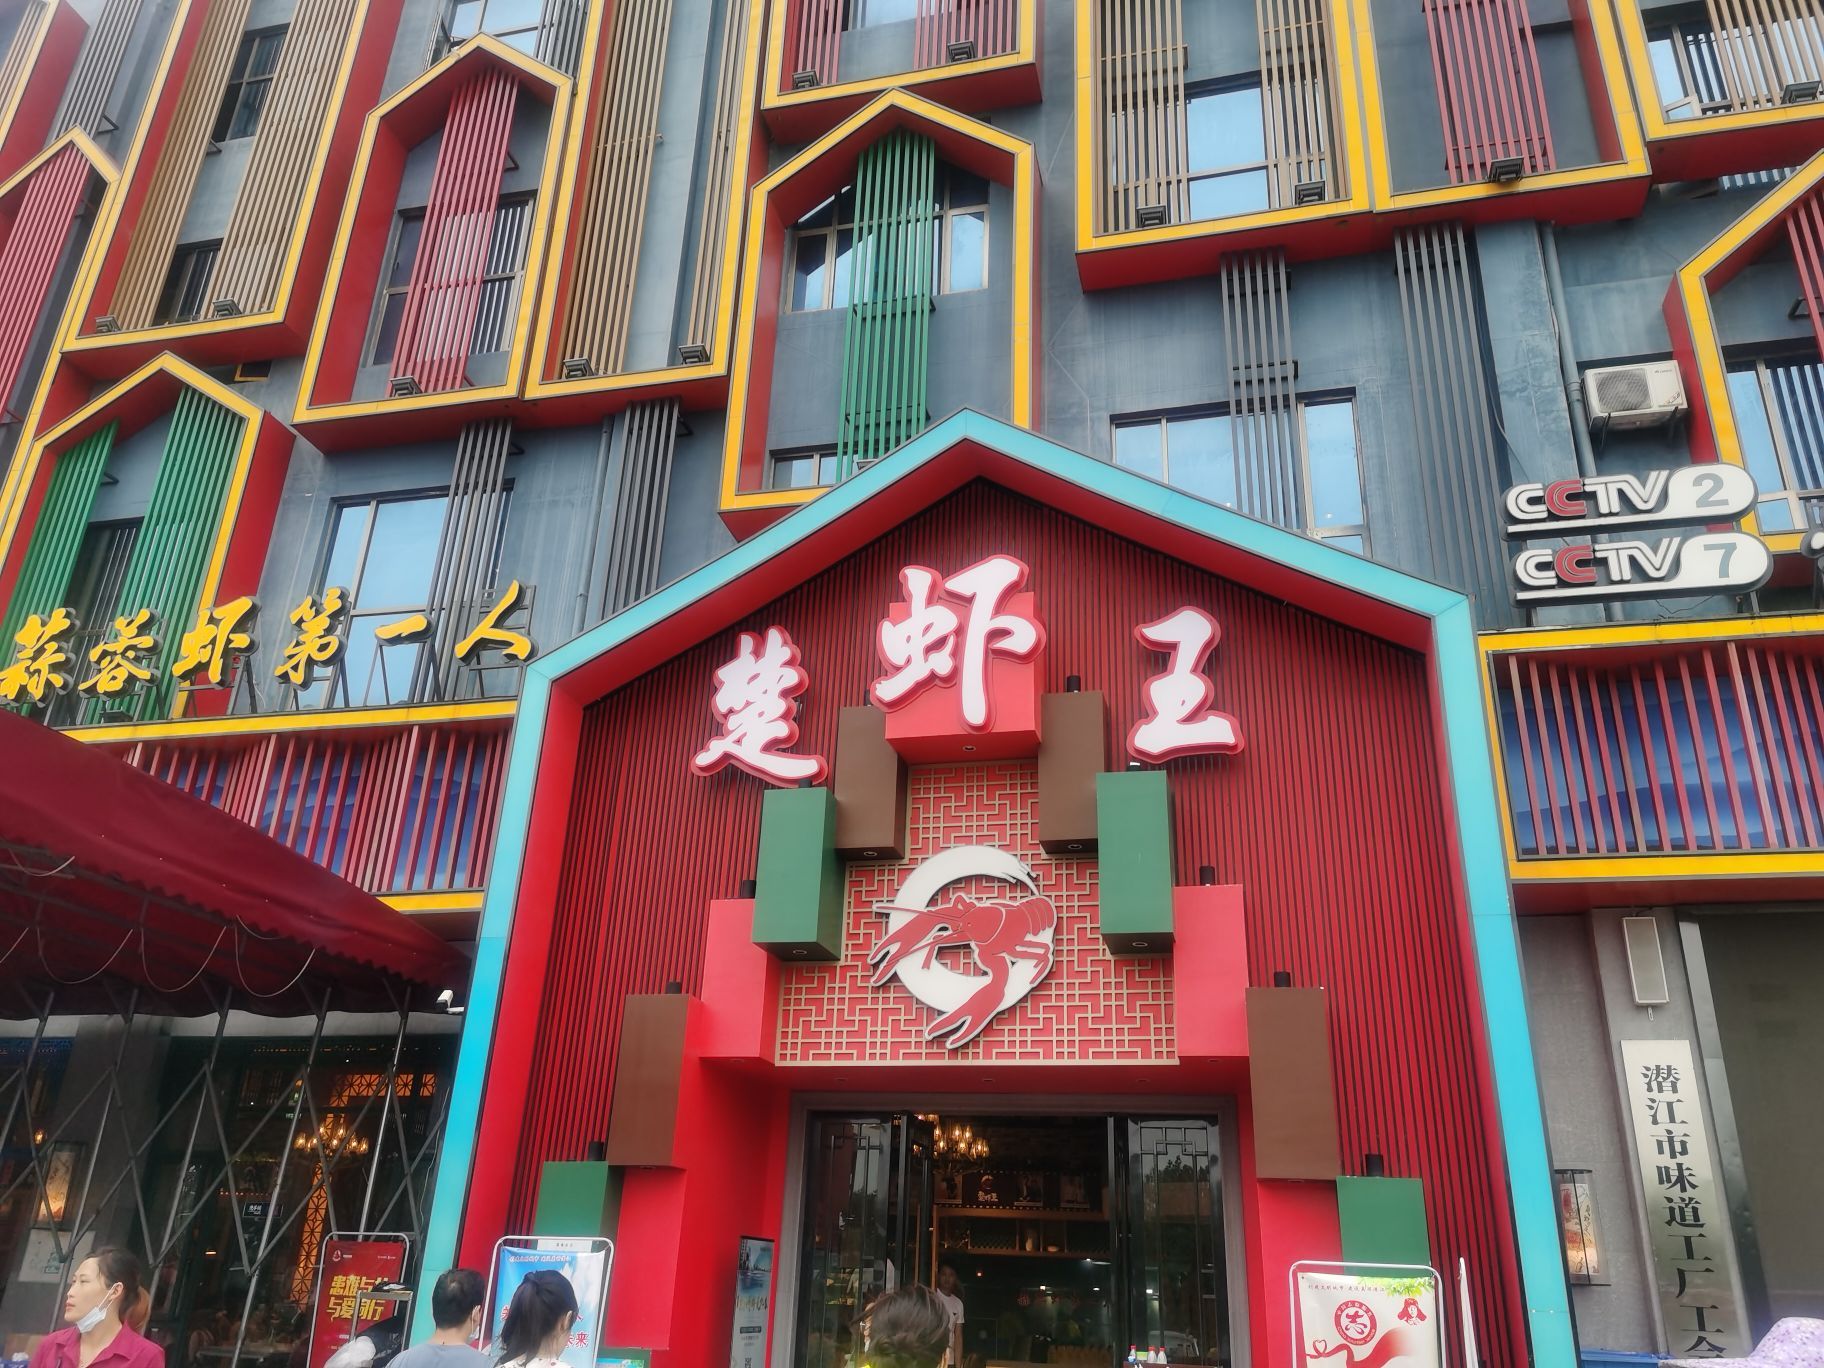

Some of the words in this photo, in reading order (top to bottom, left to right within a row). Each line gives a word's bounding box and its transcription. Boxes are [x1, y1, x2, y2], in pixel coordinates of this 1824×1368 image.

[1506, 470, 1668, 519] CCTV
[1692, 472, 1730, 509] 2
[1515, 537, 1680, 585] CCTV
[1703, 541, 1738, 580] 7
[0, 580, 535, 702] 蒜蓉虾第一人
[691, 555, 1243, 782] 楚虾王
